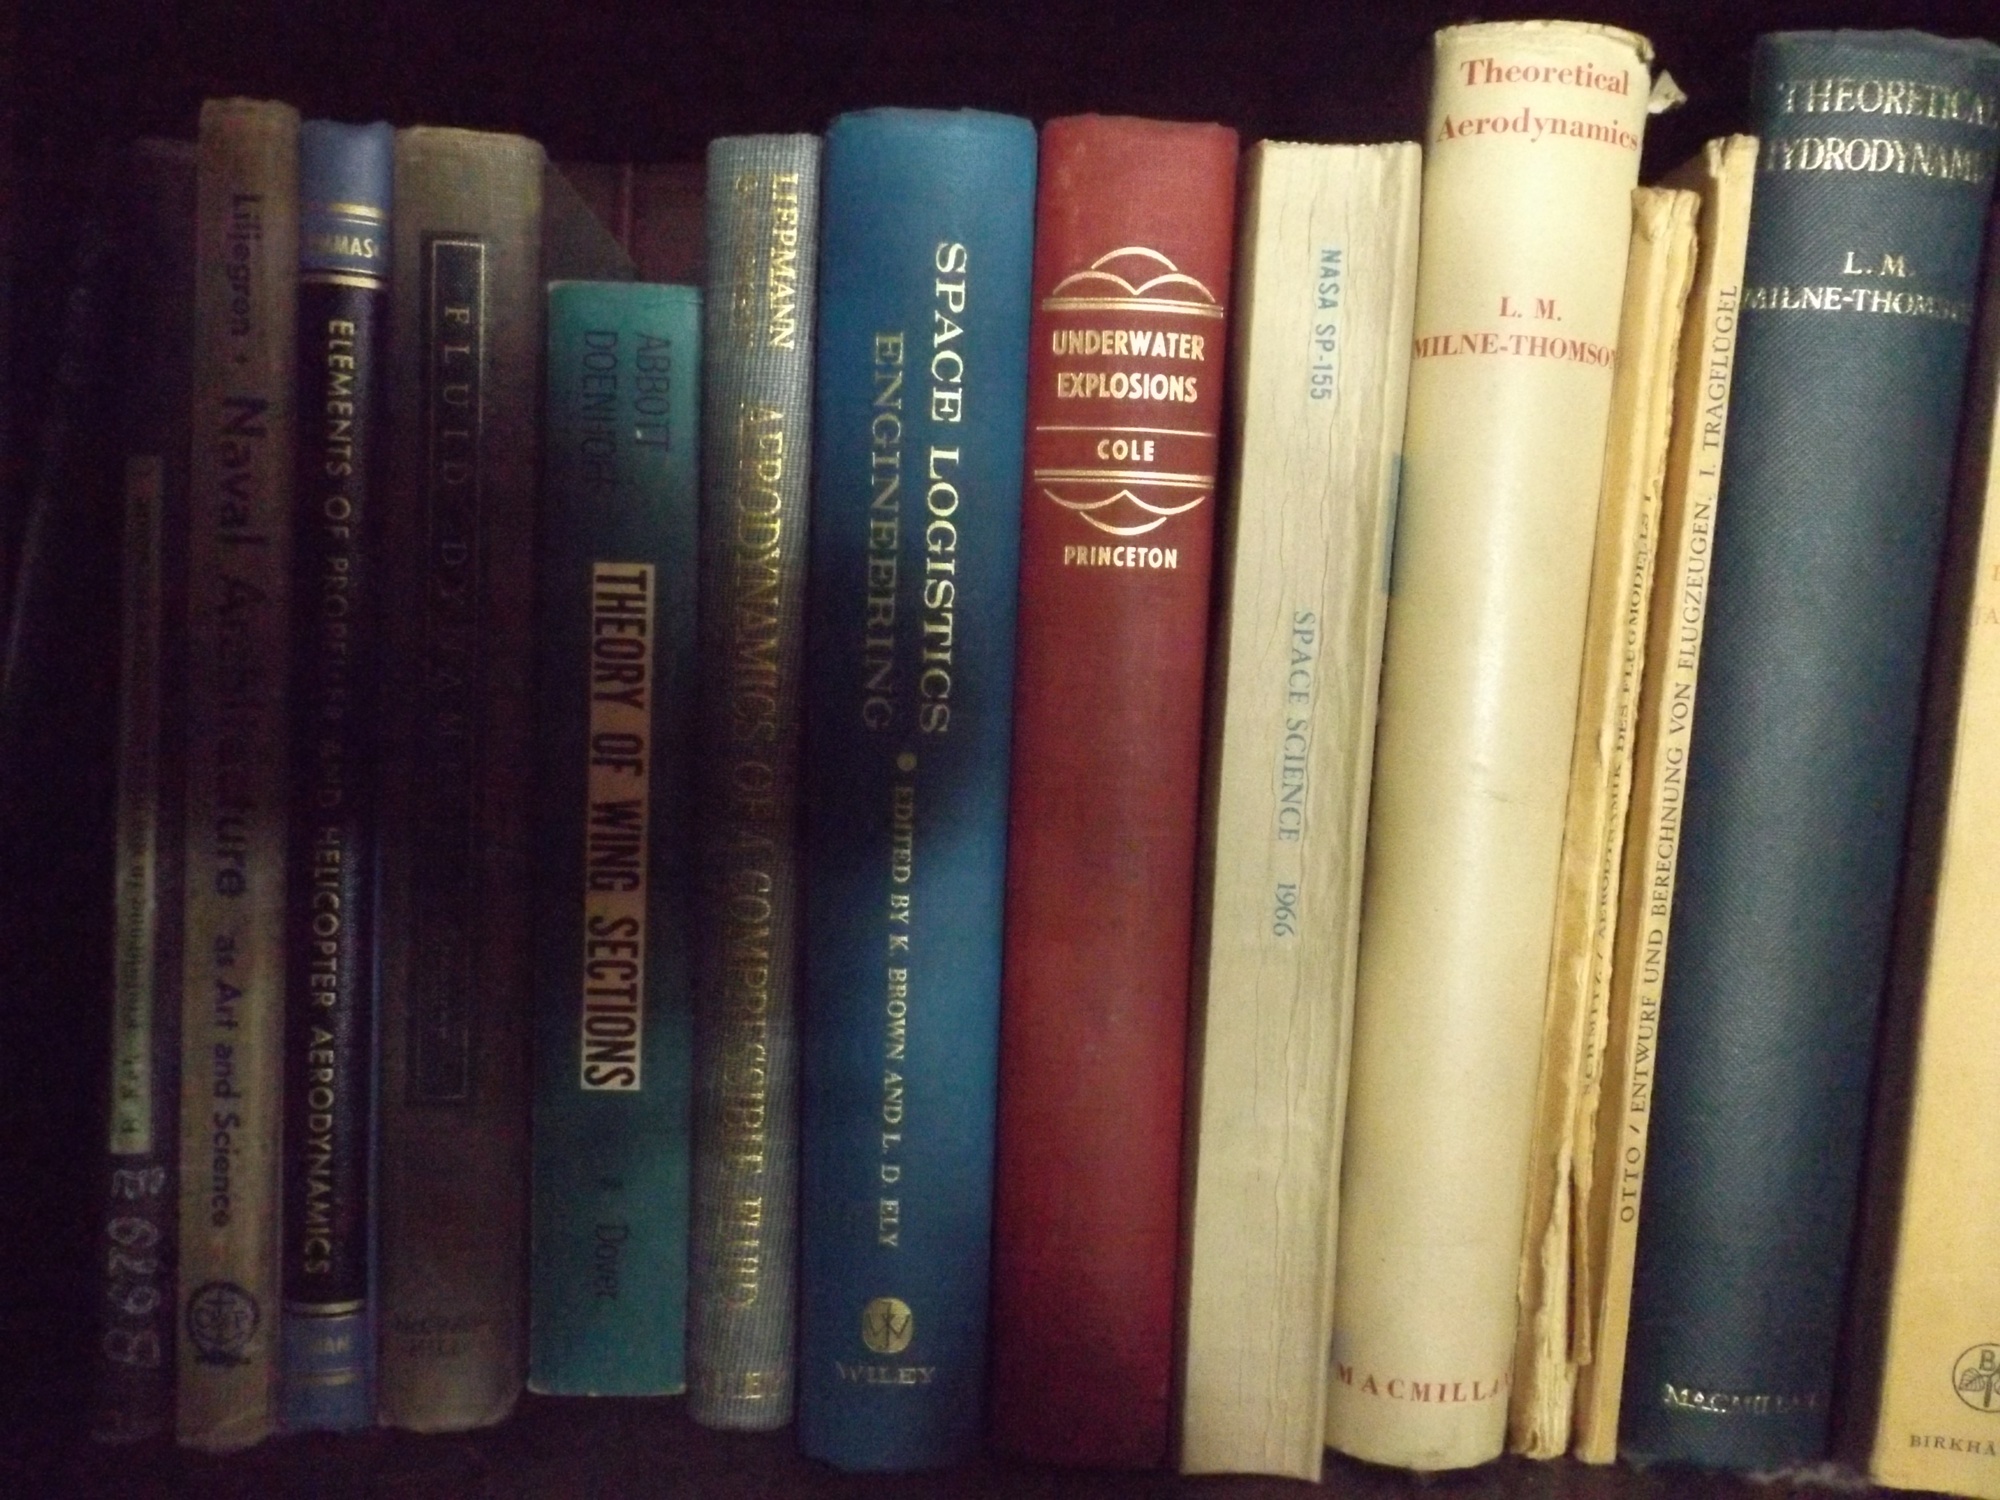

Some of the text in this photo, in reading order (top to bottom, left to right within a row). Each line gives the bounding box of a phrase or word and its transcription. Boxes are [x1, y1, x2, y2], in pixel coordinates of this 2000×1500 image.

[1436, 107, 1638, 151] Aerodynamics
[1461, 57, 1630, 96] Theoretical
[1500, 296, 1562, 322] L. M.
[1843, 252, 1872, 275] L.
[1052, 330, 1205, 361] UNDERWATER
[1309, 248, 1343, 401] NASA SP-155
[1701, 284, 1738, 450] TRAGFLÜGEL
[324, 318, 356, 477] ELEMENTS
[440, 304, 473, 487] FLUID
[634, 330, 673, 452] ABBOTT
[1057, 372, 1198, 403] EXPLOSIONS
[216, 396, 268, 546] Naval
[918, 240, 970, 734] SPACE LOGISTICS
[1097, 438, 1155, 462] COLE
[323, 494, 353, 540] OF
[861, 330, 906, 732] ENGINEERING
[1064, 545, 1178, 569] PRINCETON
[1667, 682, 1692, 734] VON
[583, 570, 648, 1087] THEORY OF WING SECTIONS
[1272, 610, 1317, 939] SPACE SCIENCE 1966
[1650, 747, 1684, 916] BERECHNUNG
[309, 826, 345, 1006] HELICOPTER
[1643, 928, 1664, 983] UND
[212, 977, 240, 1032] Art
[876, 785, 914, 1249] EDITED BY K. BROWN AND L. D. ELY
[1629, 996, 1656, 1113] ENTWURF
[210, 1041, 240, 1099] and
[209, 1110, 238, 1229] Science
[302, 1024, 339, 1274] AERODYNAMICS
[1620, 1146, 1642, 1223] OTTO
[836, 1361, 935, 1384] WILEY
